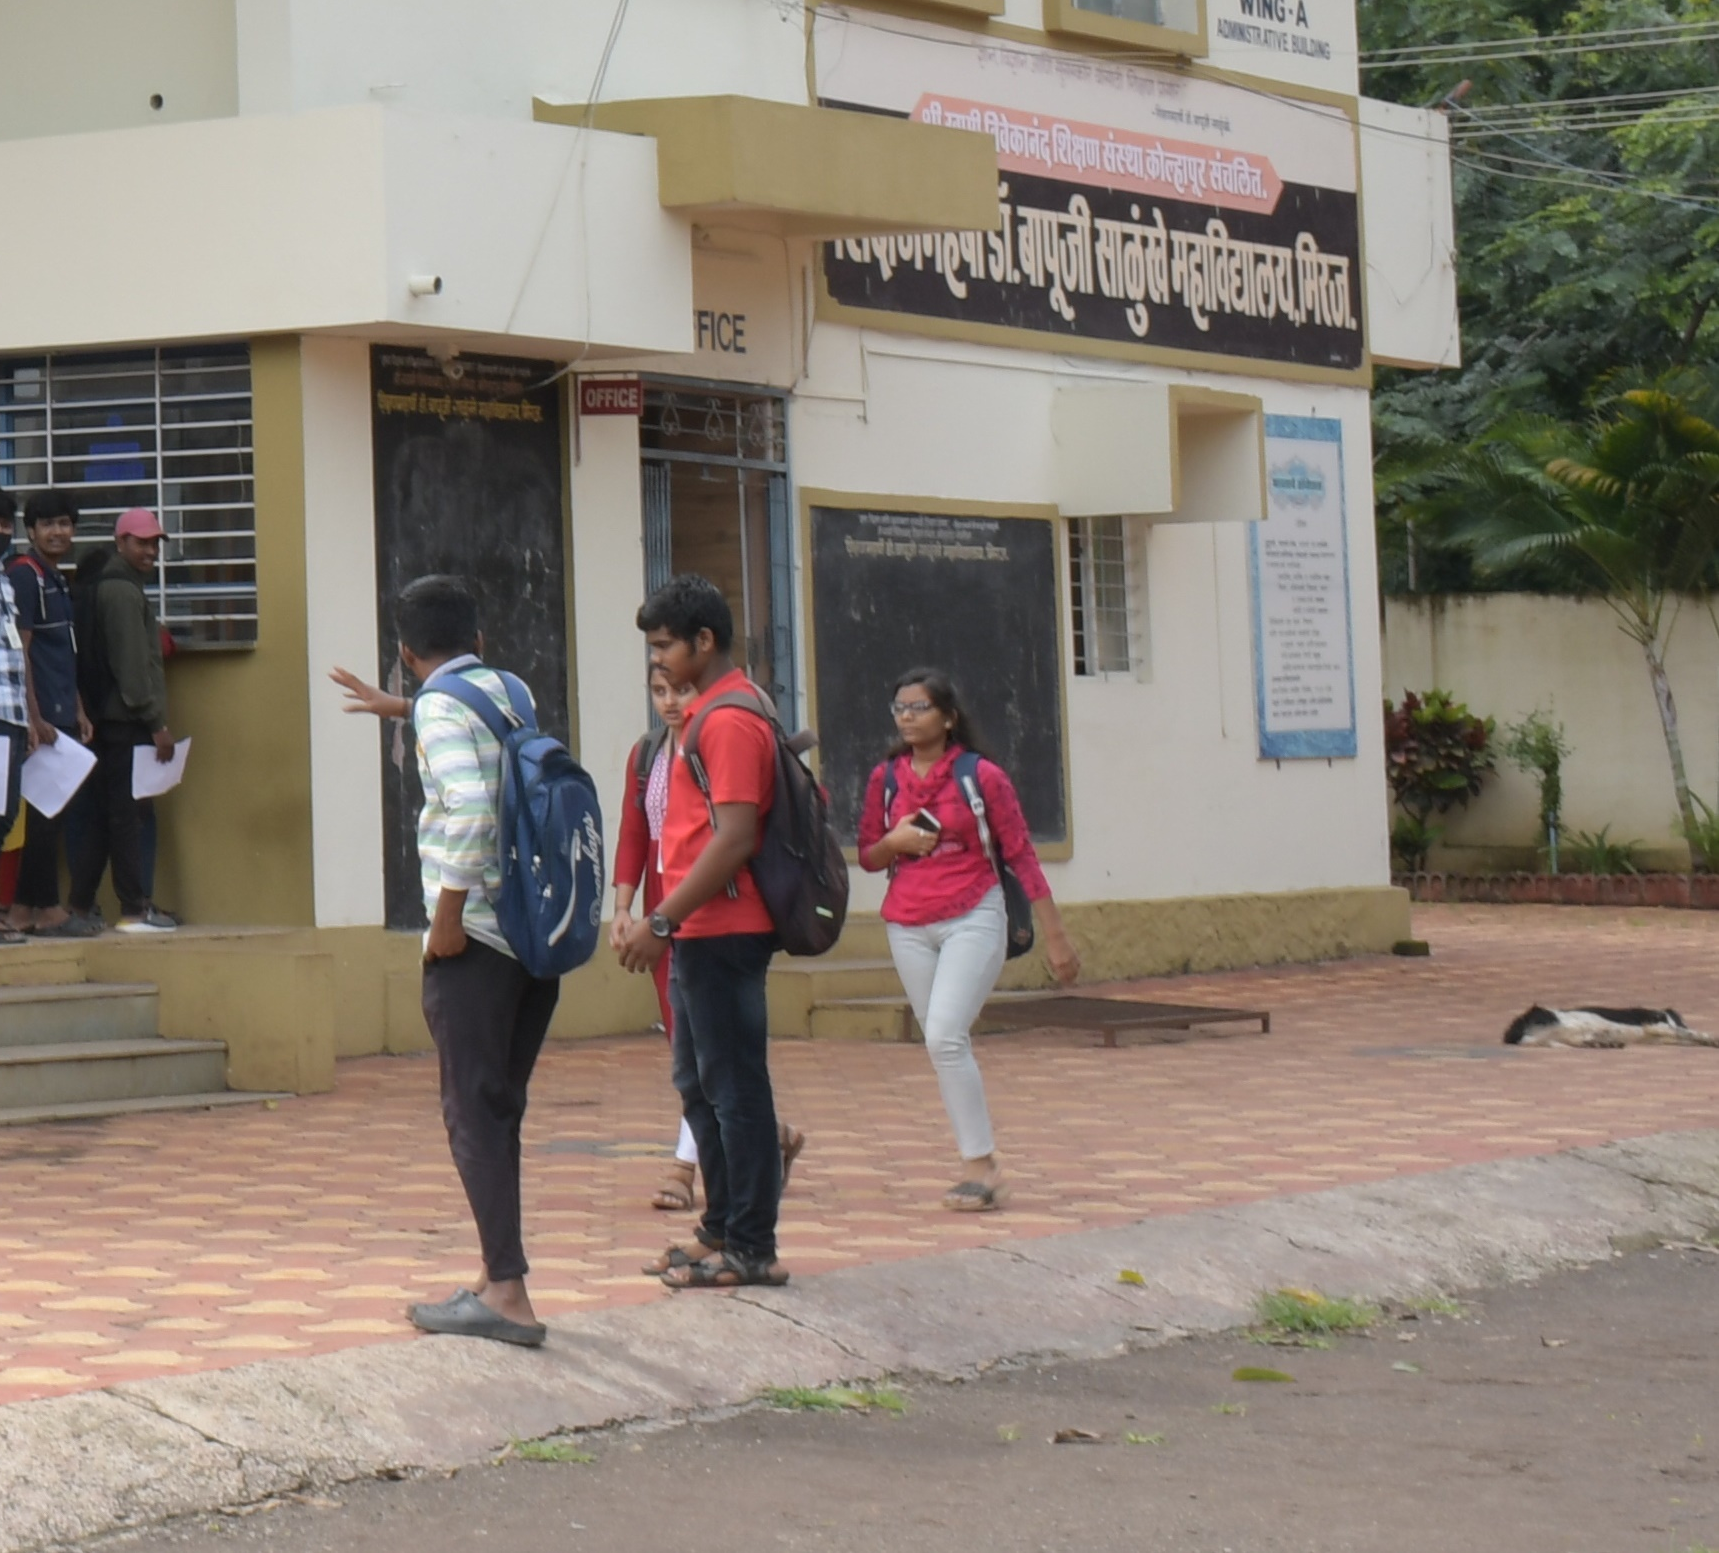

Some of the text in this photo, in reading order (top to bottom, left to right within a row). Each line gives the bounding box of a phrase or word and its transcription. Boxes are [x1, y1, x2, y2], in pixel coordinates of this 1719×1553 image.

[1217, 17, 1331, 61] ADMINISTRATIVE BUILDING
[1052, 123, 1100, 173] शिक्षण
[1209, 150, 1268, 199] संचलित.
[1017, 193, 1094, 321] बापूजी
[1094, 203, 1170, 337] साळुंखे
[1170, 217, 1301, 332] महाविद्यालय,
[1295, 231, 1358, 331] मिरज.
[693, 310, 746, 354] FICE
[585, 386, 639, 408] OFFICE
